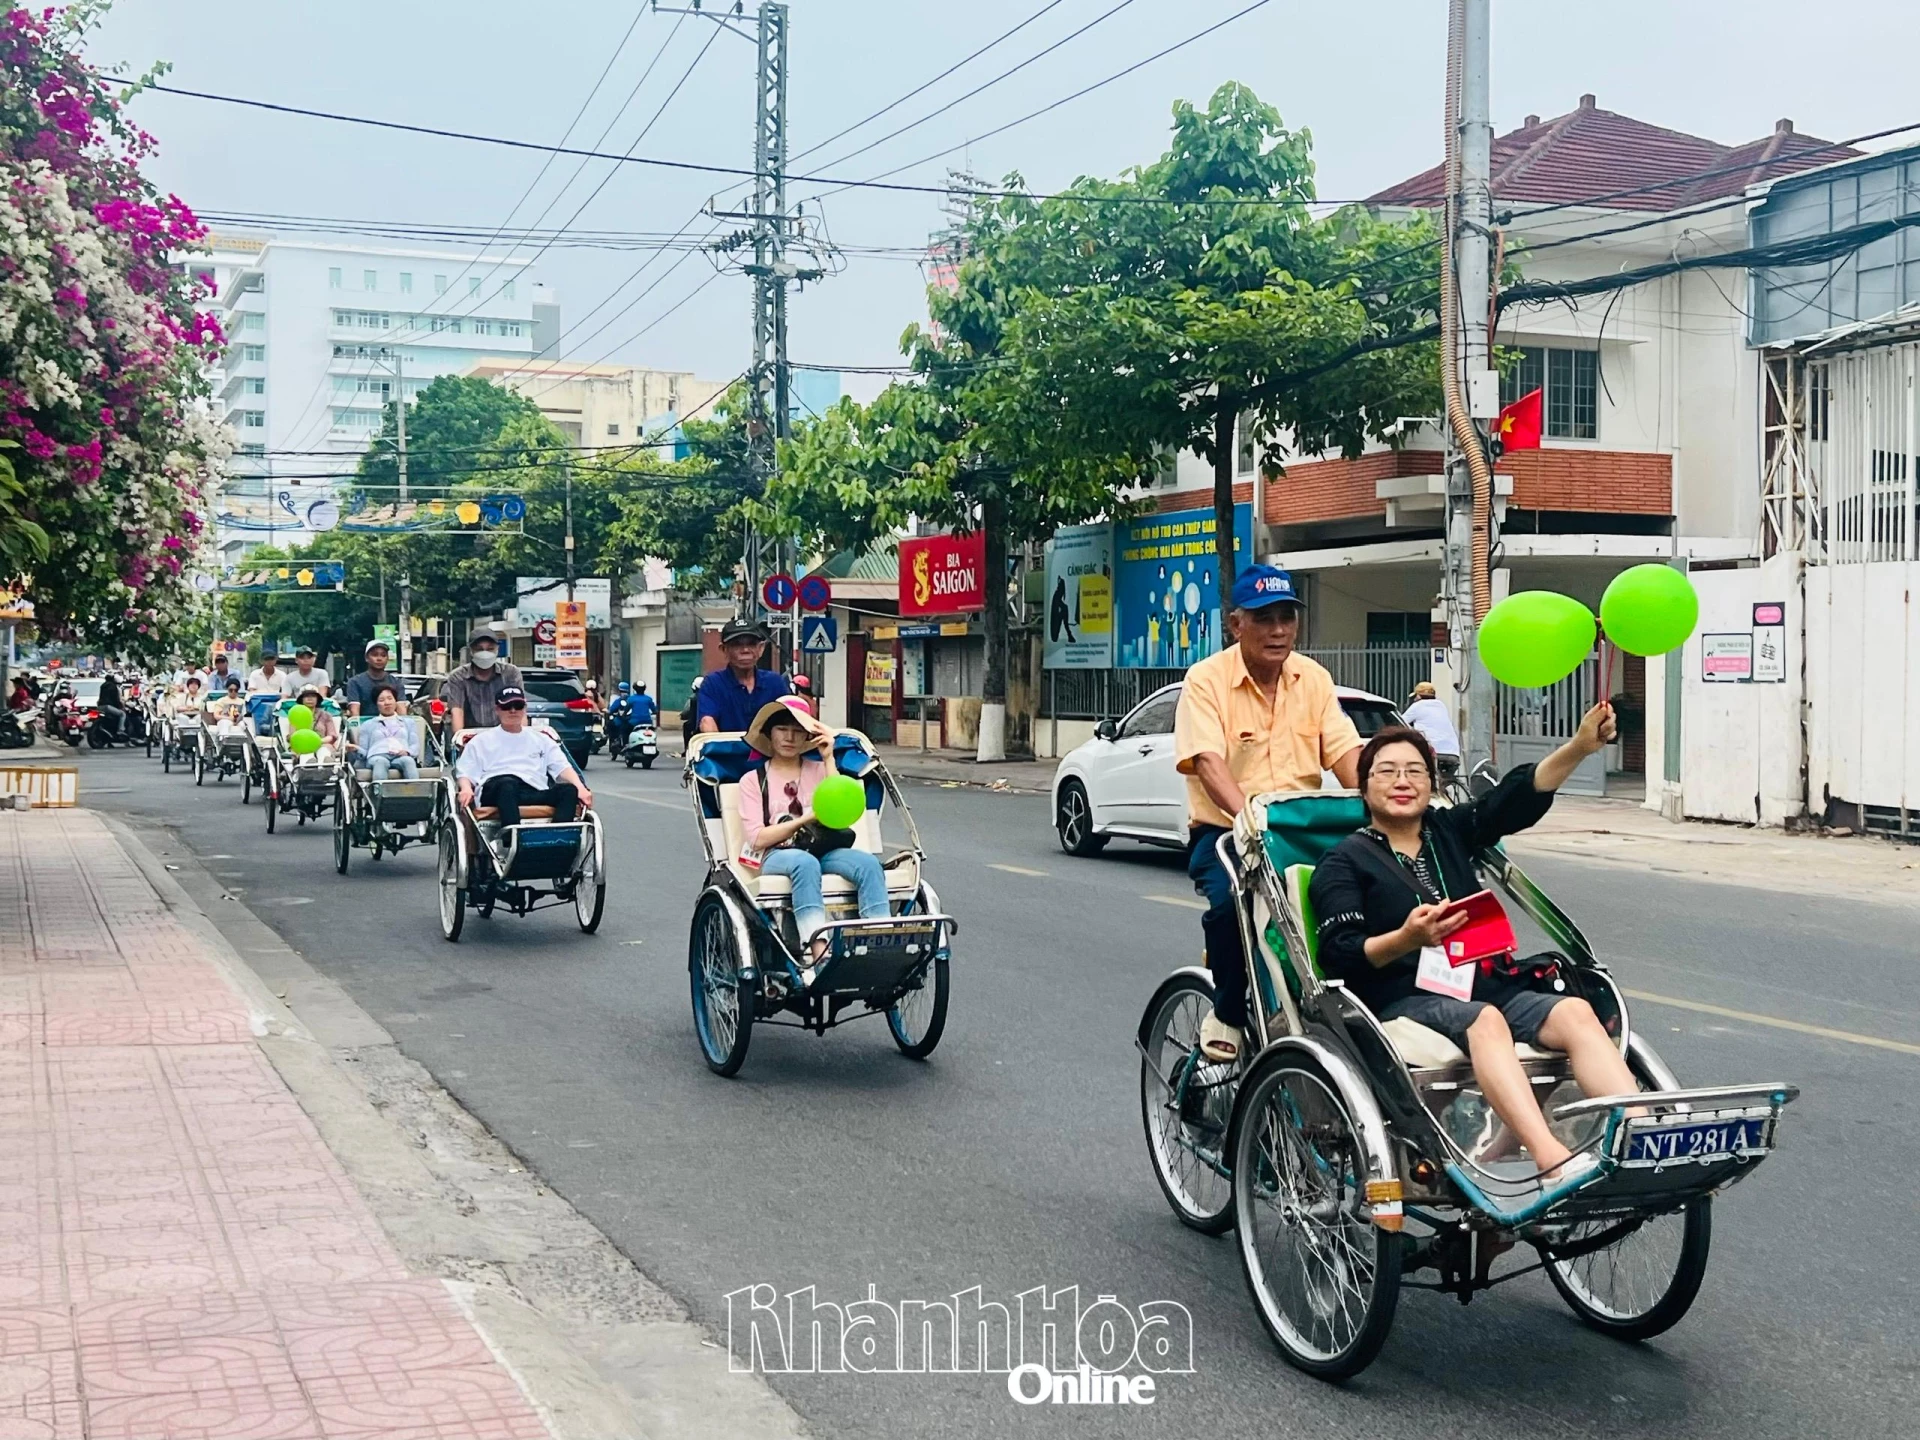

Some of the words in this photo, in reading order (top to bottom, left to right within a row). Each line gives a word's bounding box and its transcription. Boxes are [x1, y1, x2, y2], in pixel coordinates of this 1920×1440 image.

[947, 553, 960, 567] BIA
[933, 568, 975, 595] SAIGON
[1642, 1133, 1683, 1159] NT
[1688, 1124, 1748, 1155] 281A
